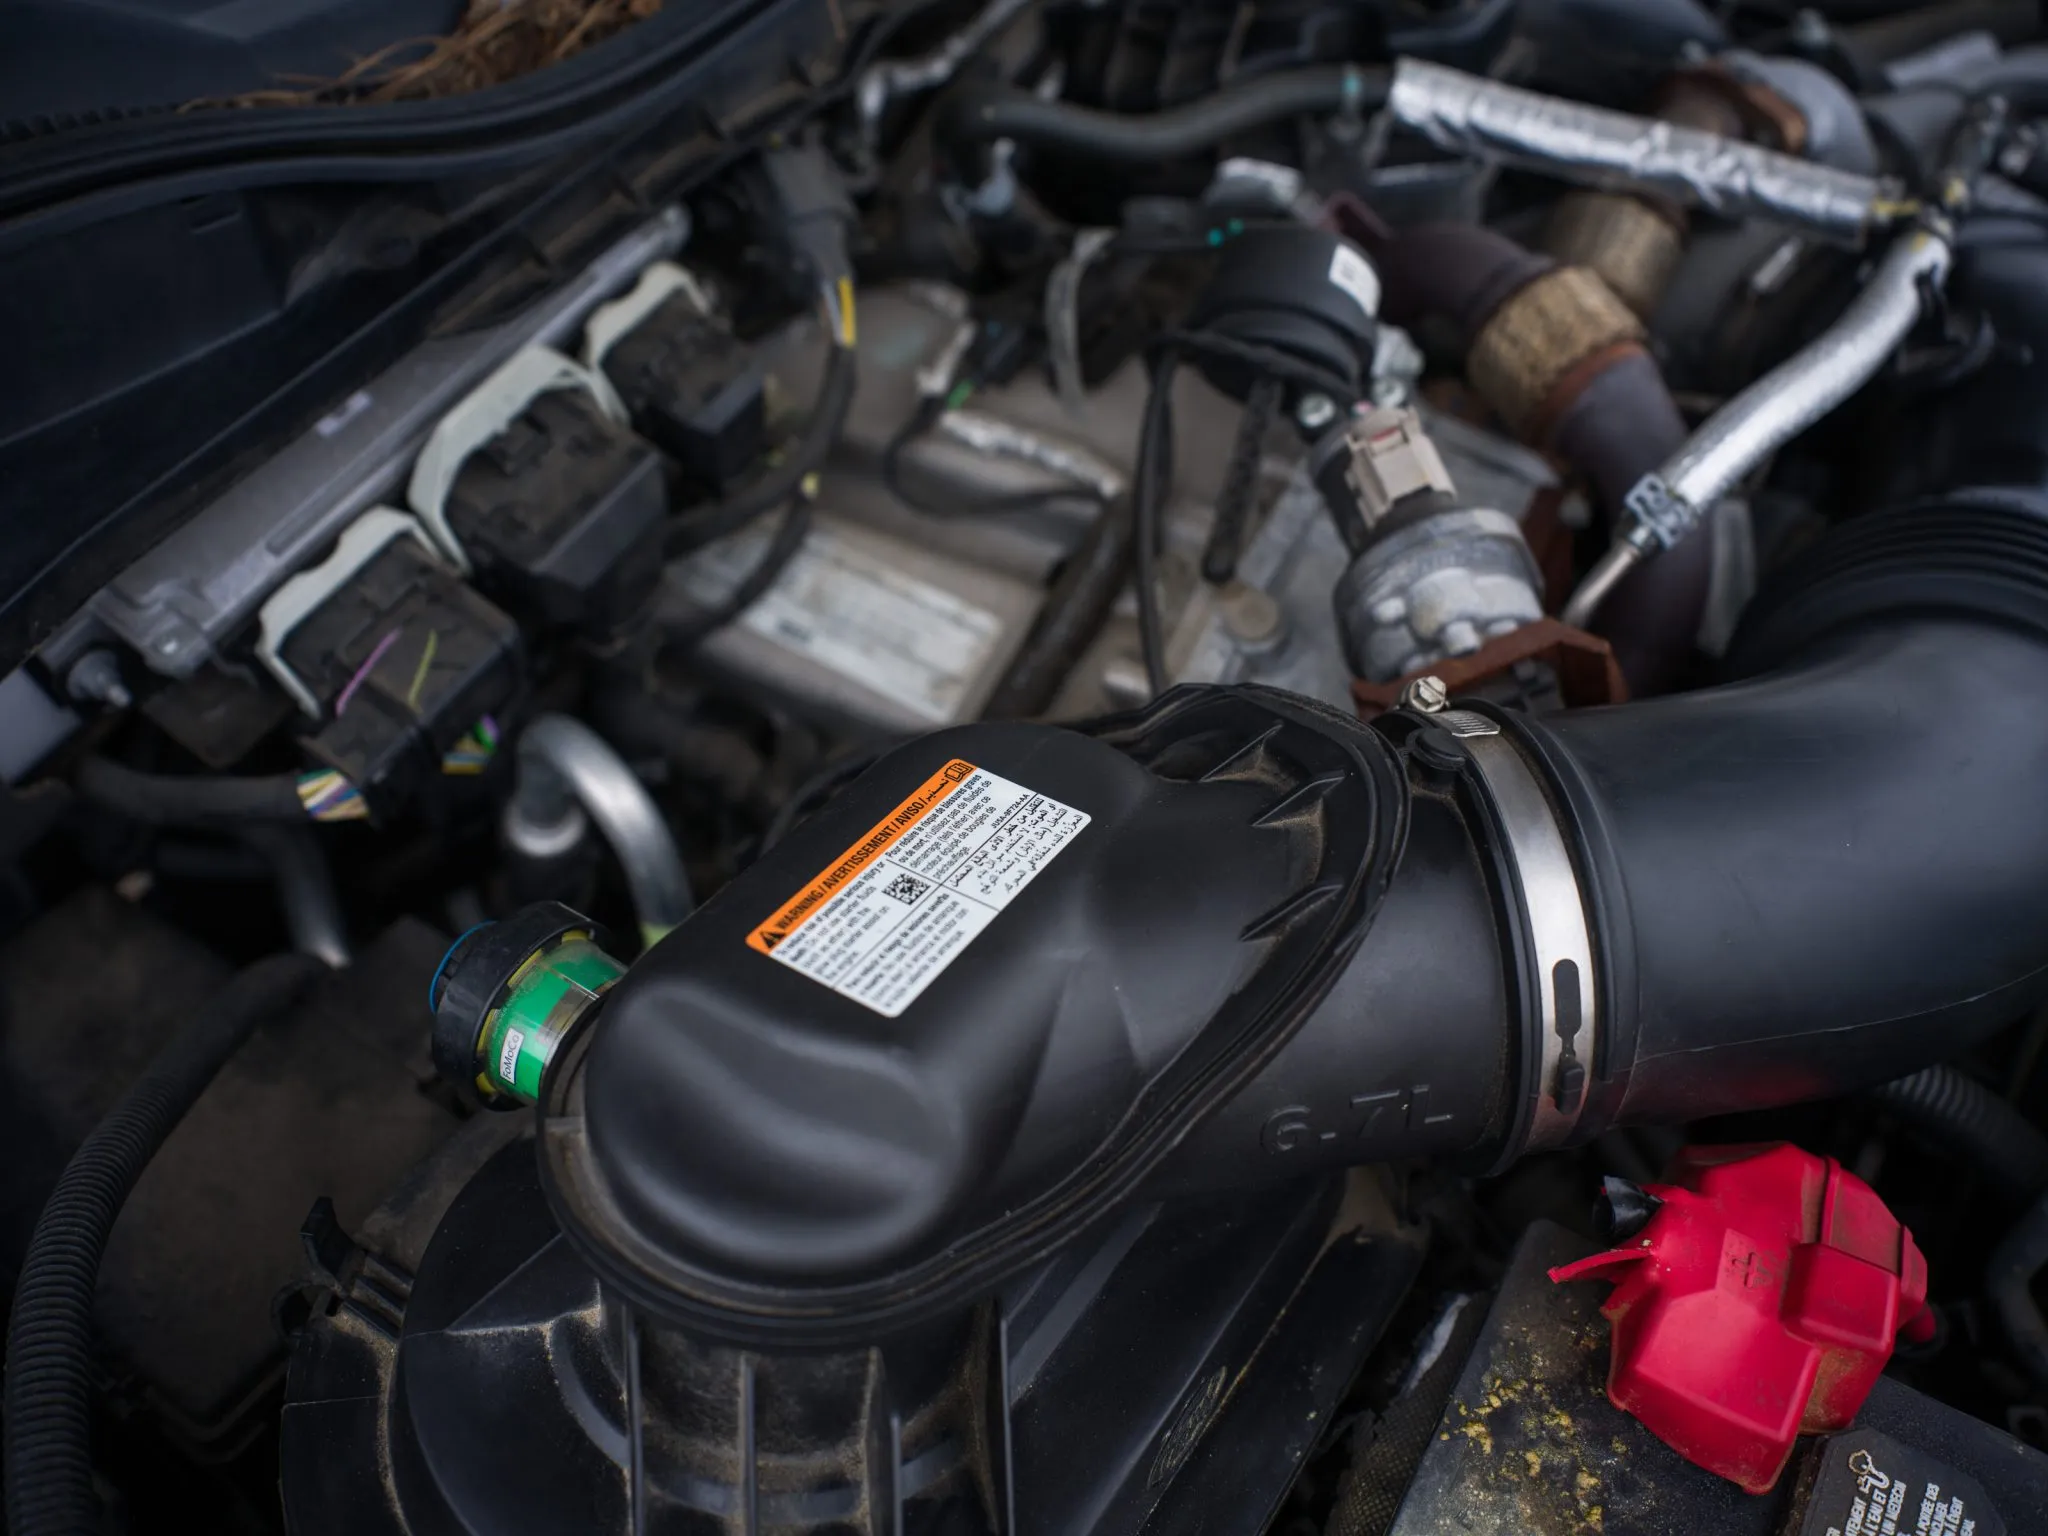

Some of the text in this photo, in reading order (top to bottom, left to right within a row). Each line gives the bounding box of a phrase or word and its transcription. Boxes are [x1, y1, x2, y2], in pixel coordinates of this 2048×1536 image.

[962, 774, 983, 790] graves
[939, 787, 968, 809] blessures
[946, 808, 961, 819] pas
[956, 801, 968, 809] de
[962, 786, 985, 803] fluides
[980, 780, 992, 788] de
[967, 801, 984, 815] avec
[980, 795, 991, 803] ce
[934, 806, 946, 814] de
[919, 812, 940, 828] risque
[957, 831, 969, 839] de
[963, 812, 990, 833] bougies
[984, 805, 997, 813] de
[898, 830, 920, 847] réduire
[884, 845, 903, 858] Pour
[775, 889, 825, 930] WARNING
[821, 825, 897, 889] AVERTISSEMENT
[894, 801, 925, 825] AVISO
[502, 1033, 521, 1081] FoMoCo
[1872, 1488, 1887, 1505] ET
[1925, 1482, 1940, 1501] DES
